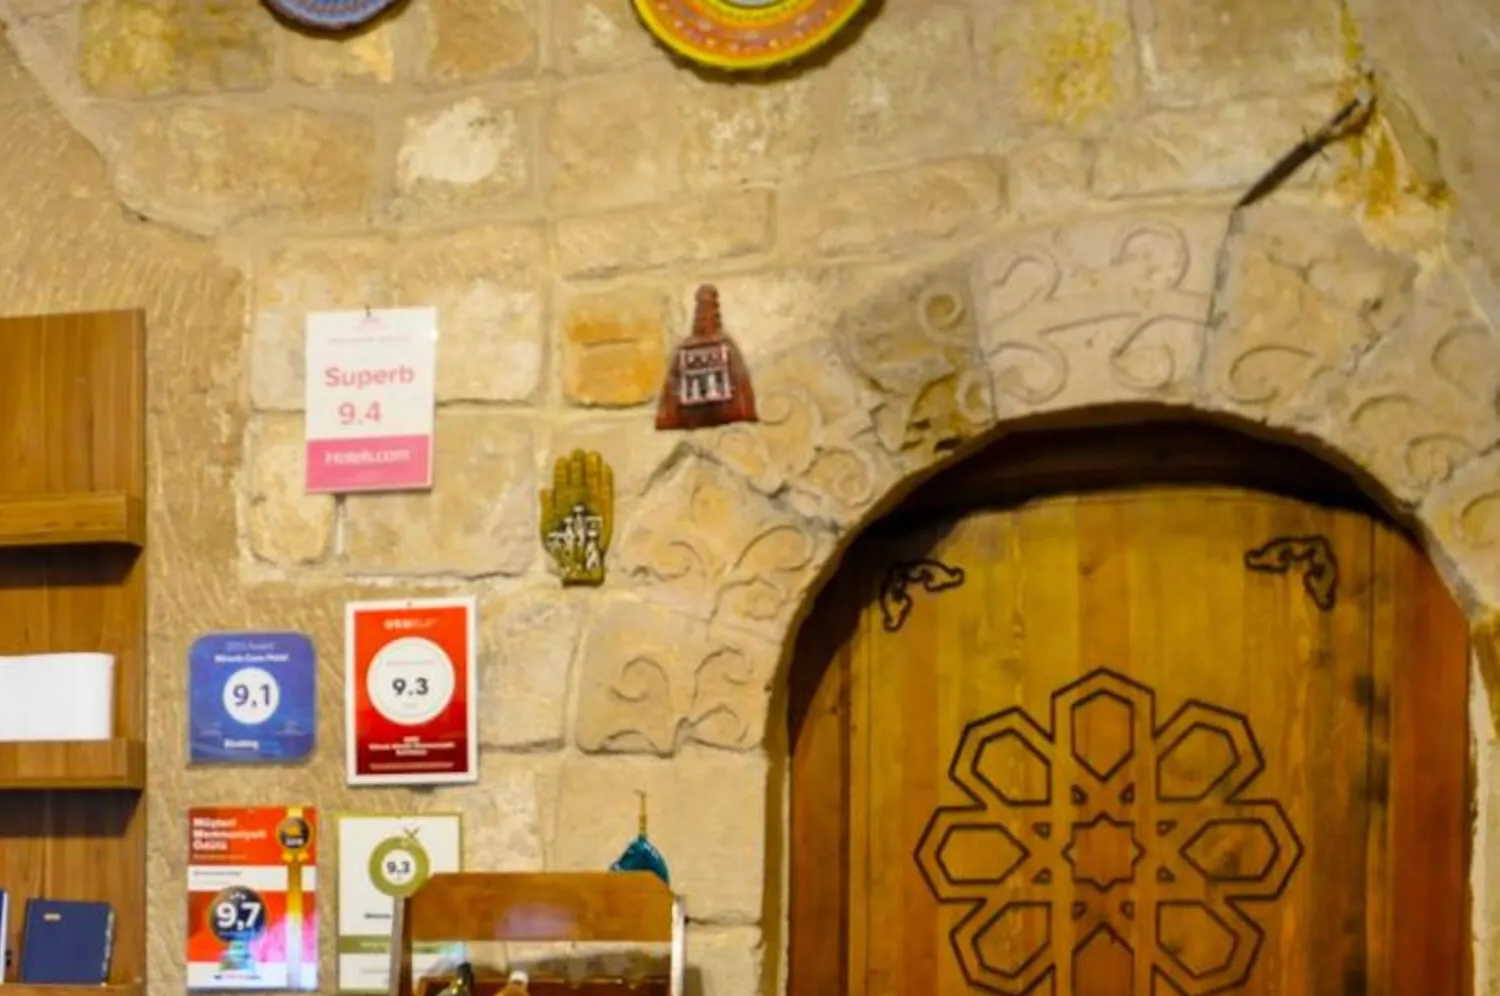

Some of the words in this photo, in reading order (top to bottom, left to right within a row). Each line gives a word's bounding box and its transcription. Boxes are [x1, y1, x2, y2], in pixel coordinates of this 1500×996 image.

[325, 365, 415, 390] Superb
[338, 400, 382, 426] 9.4
[392, 677, 429, 697] 9.3
